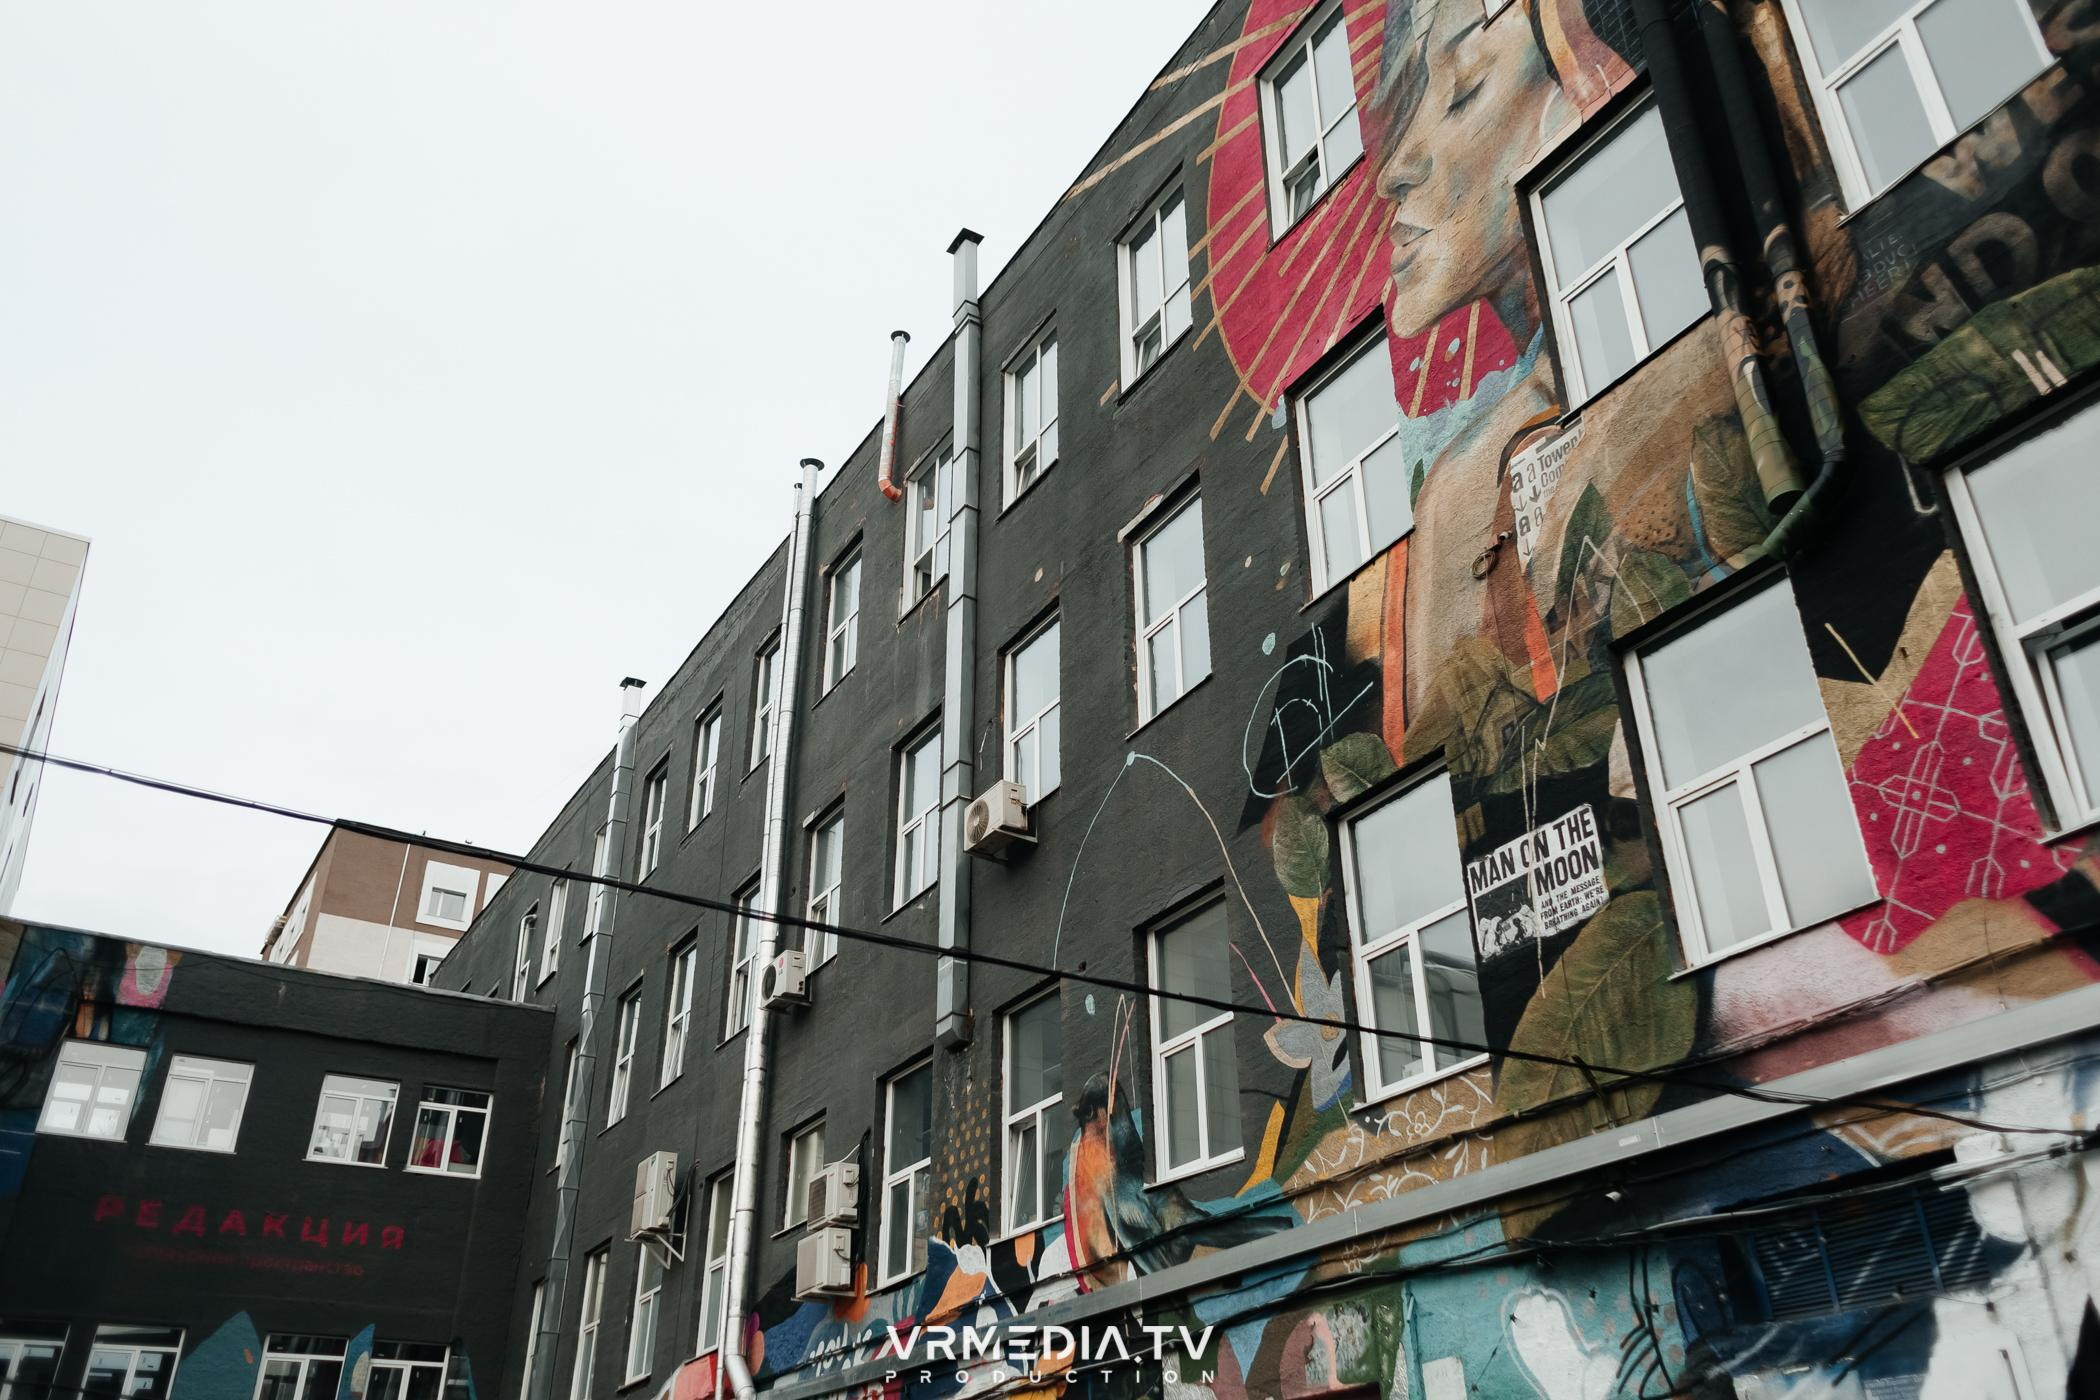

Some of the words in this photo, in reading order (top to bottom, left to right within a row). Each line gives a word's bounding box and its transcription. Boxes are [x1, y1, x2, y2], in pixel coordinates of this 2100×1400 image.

[1470, 848, 1516, 894] MAN
[1520, 830, 1550, 868] ON
[1553, 807, 1594, 850] THE
[1534, 841, 1599, 896] MOON
[1540, 905, 1558, 920] FROM
[1541, 897, 1553, 909] AND
[1556, 891, 1569, 902] THE
[1571, 876, 1601, 895] MESSAGE
[1544, 908, 1579, 930] BREATHING
[94, 1194, 406, 1248] РЕДАКЦИЯ
